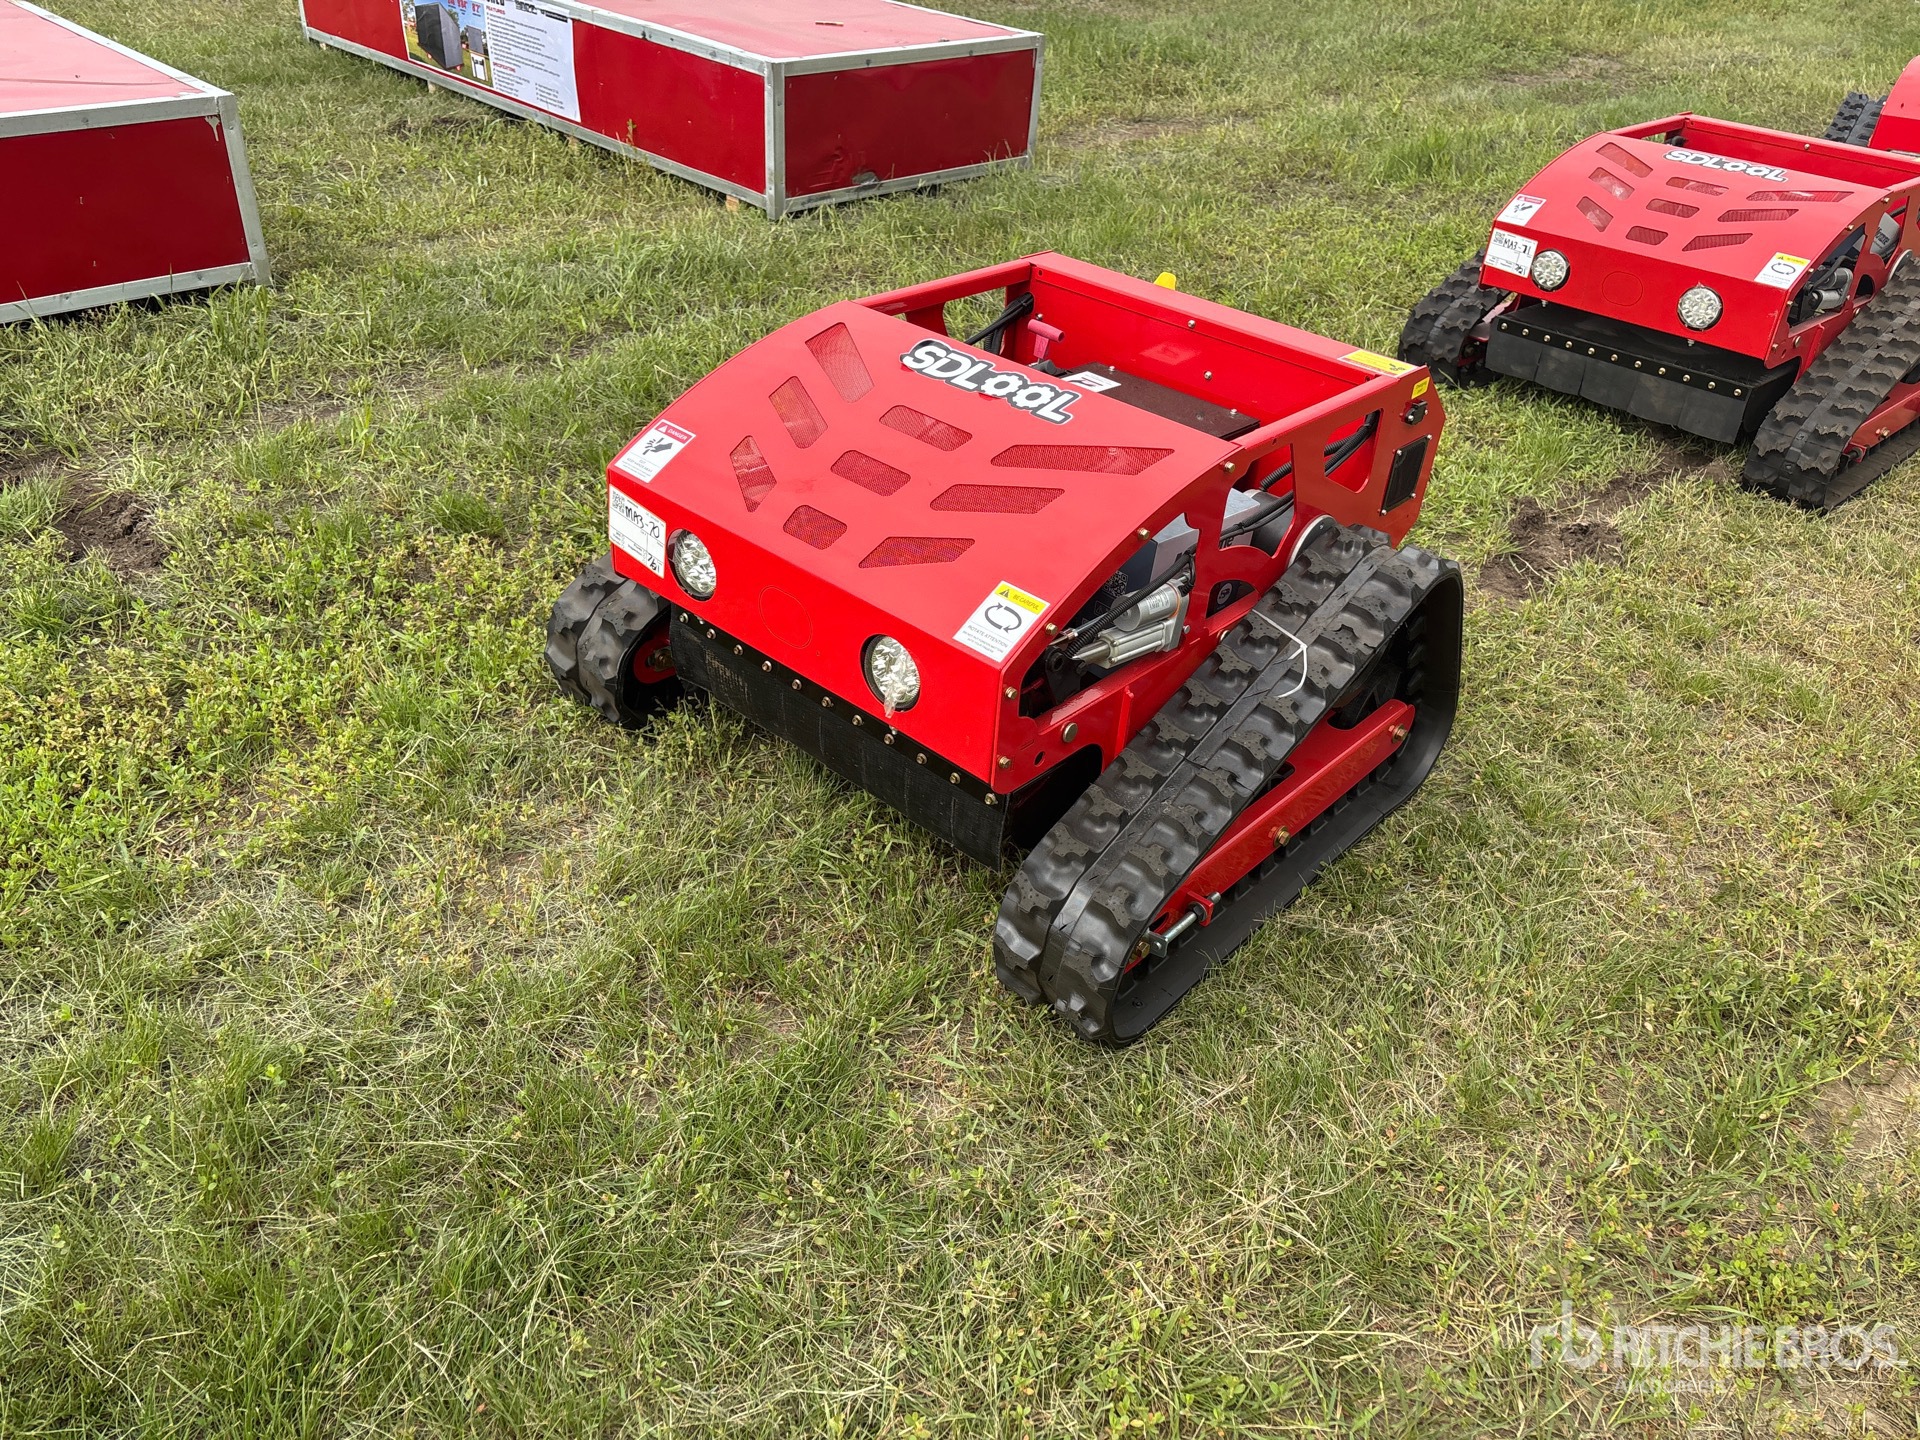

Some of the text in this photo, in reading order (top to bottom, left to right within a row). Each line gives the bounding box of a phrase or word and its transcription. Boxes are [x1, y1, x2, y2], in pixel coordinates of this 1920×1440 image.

[1663, 149, 1788, 182] SDLOOL
[900, 340, 1081, 424] SDLOOL
[667, 428, 688, 441] DANGER
[1019, 597, 1039, 610] CAREFUL
[984, 633, 1008, 648] ATTENTION
